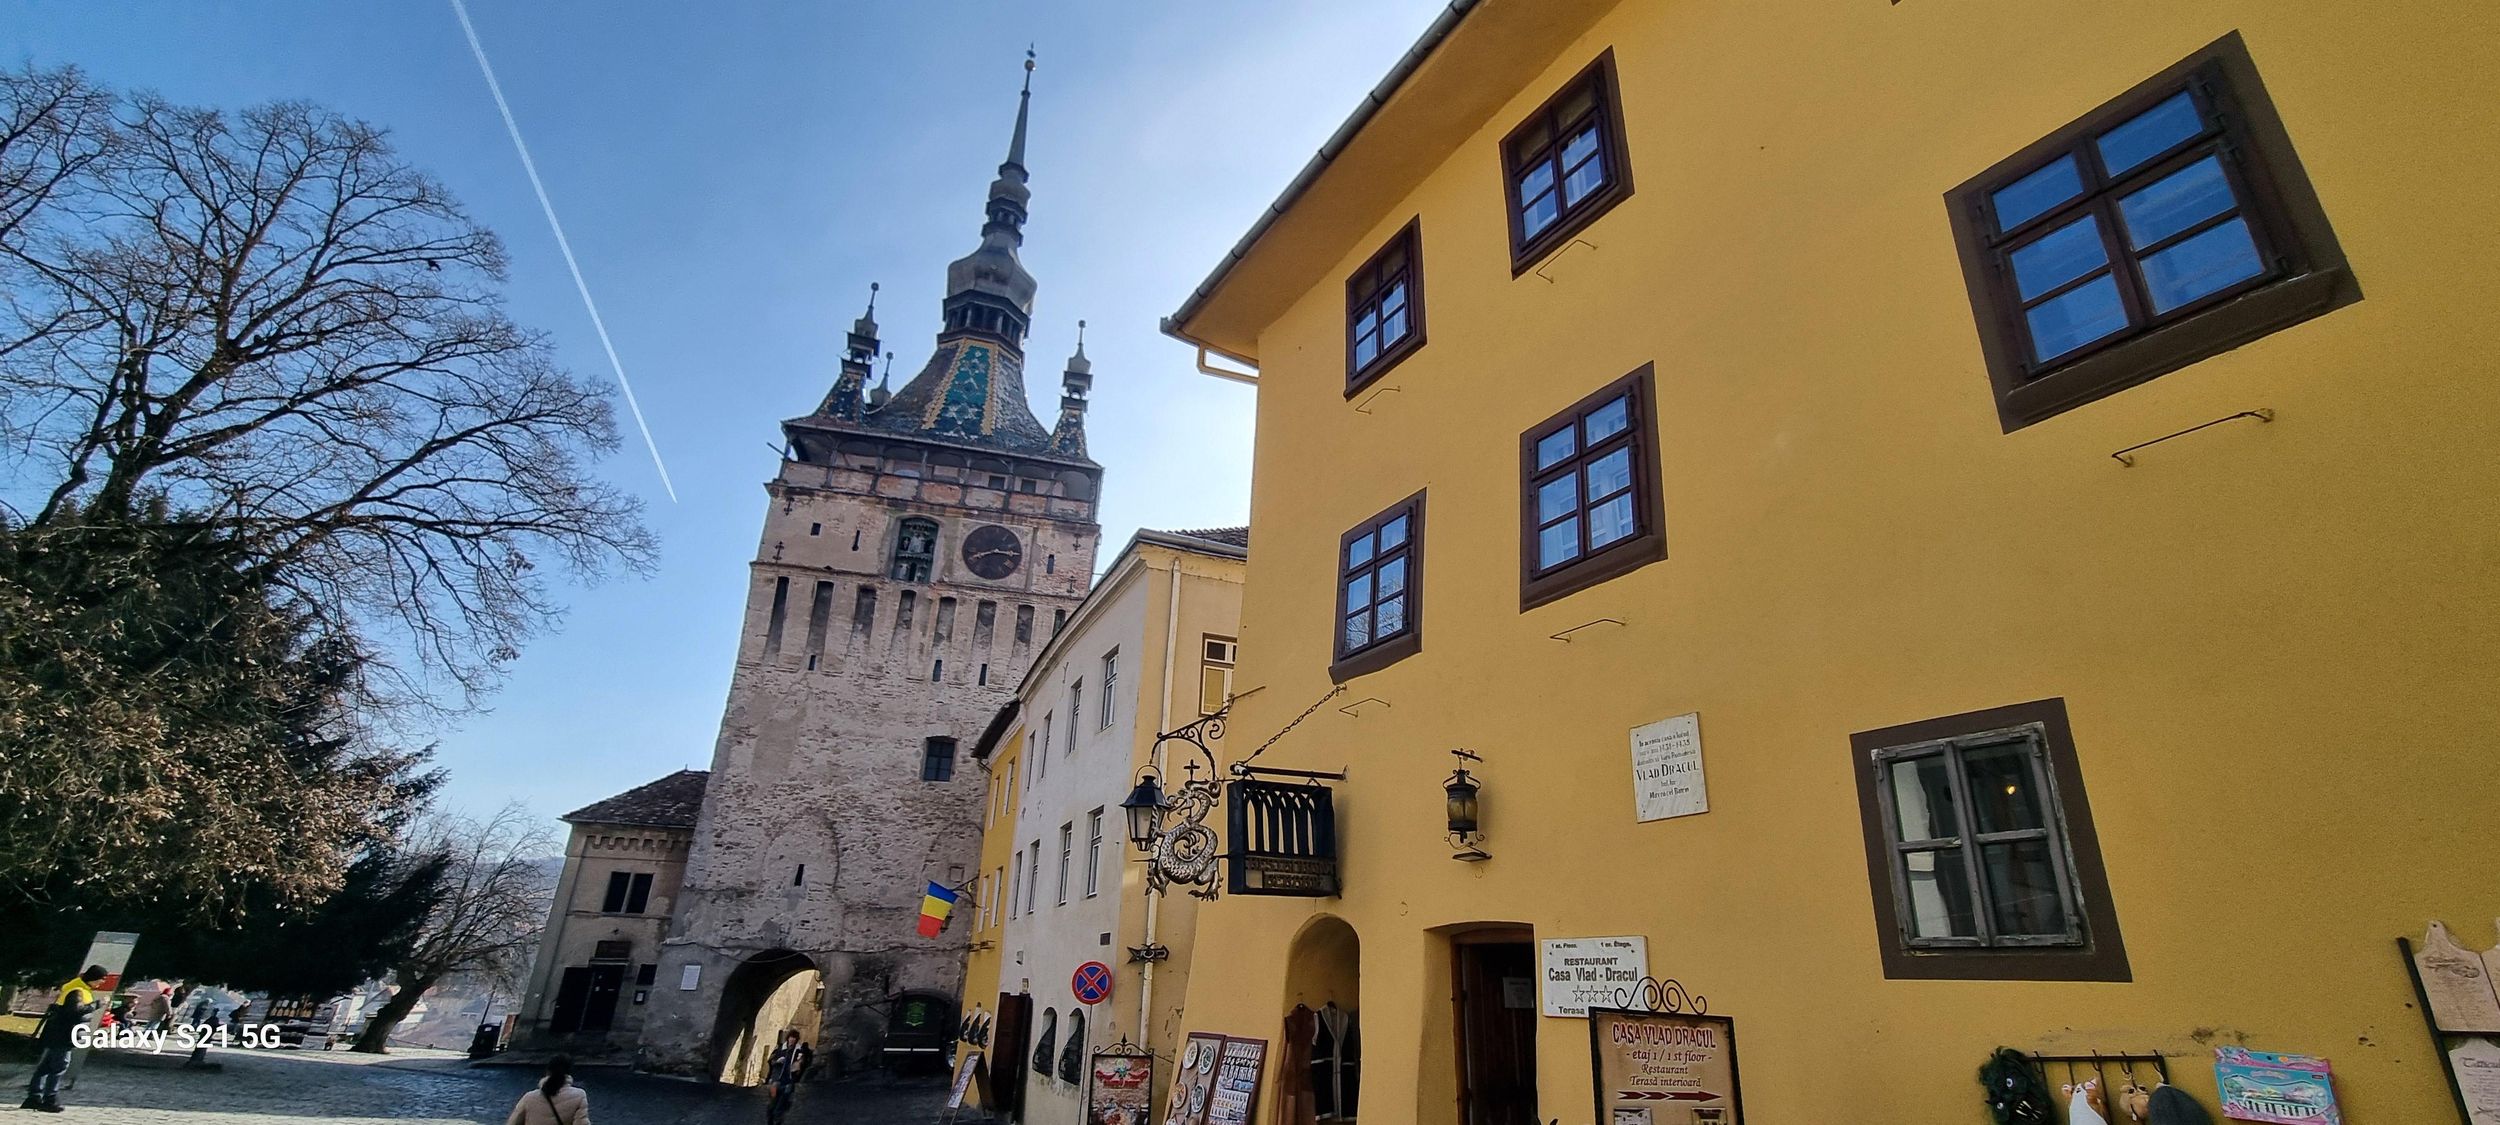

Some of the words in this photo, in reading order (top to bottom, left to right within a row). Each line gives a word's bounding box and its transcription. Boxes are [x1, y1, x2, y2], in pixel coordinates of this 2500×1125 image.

[1636, 769, 1660, 781] VLAD
[1661, 760, 1699, 777] DRACUL
[1564, 957, 1618, 966] RESTAURANT
[1548, 967, 1571, 981] Casa
[1575, 967, 1597, 981] Vlad
[1605, 966, 1638, 982] Dracul
[1612, 1023, 1641, 1045] CASA
[1643, 1025, 1672, 1046] VLAD
[1675, 1027, 1716, 1049] DRACUL
[1632, 1049, 1651, 1063] etaj
[1674, 1052, 1682, 1061] st
[1683, 1050, 1706, 1064] floor
[1641, 1064, 1688, 1075] Restaurant
